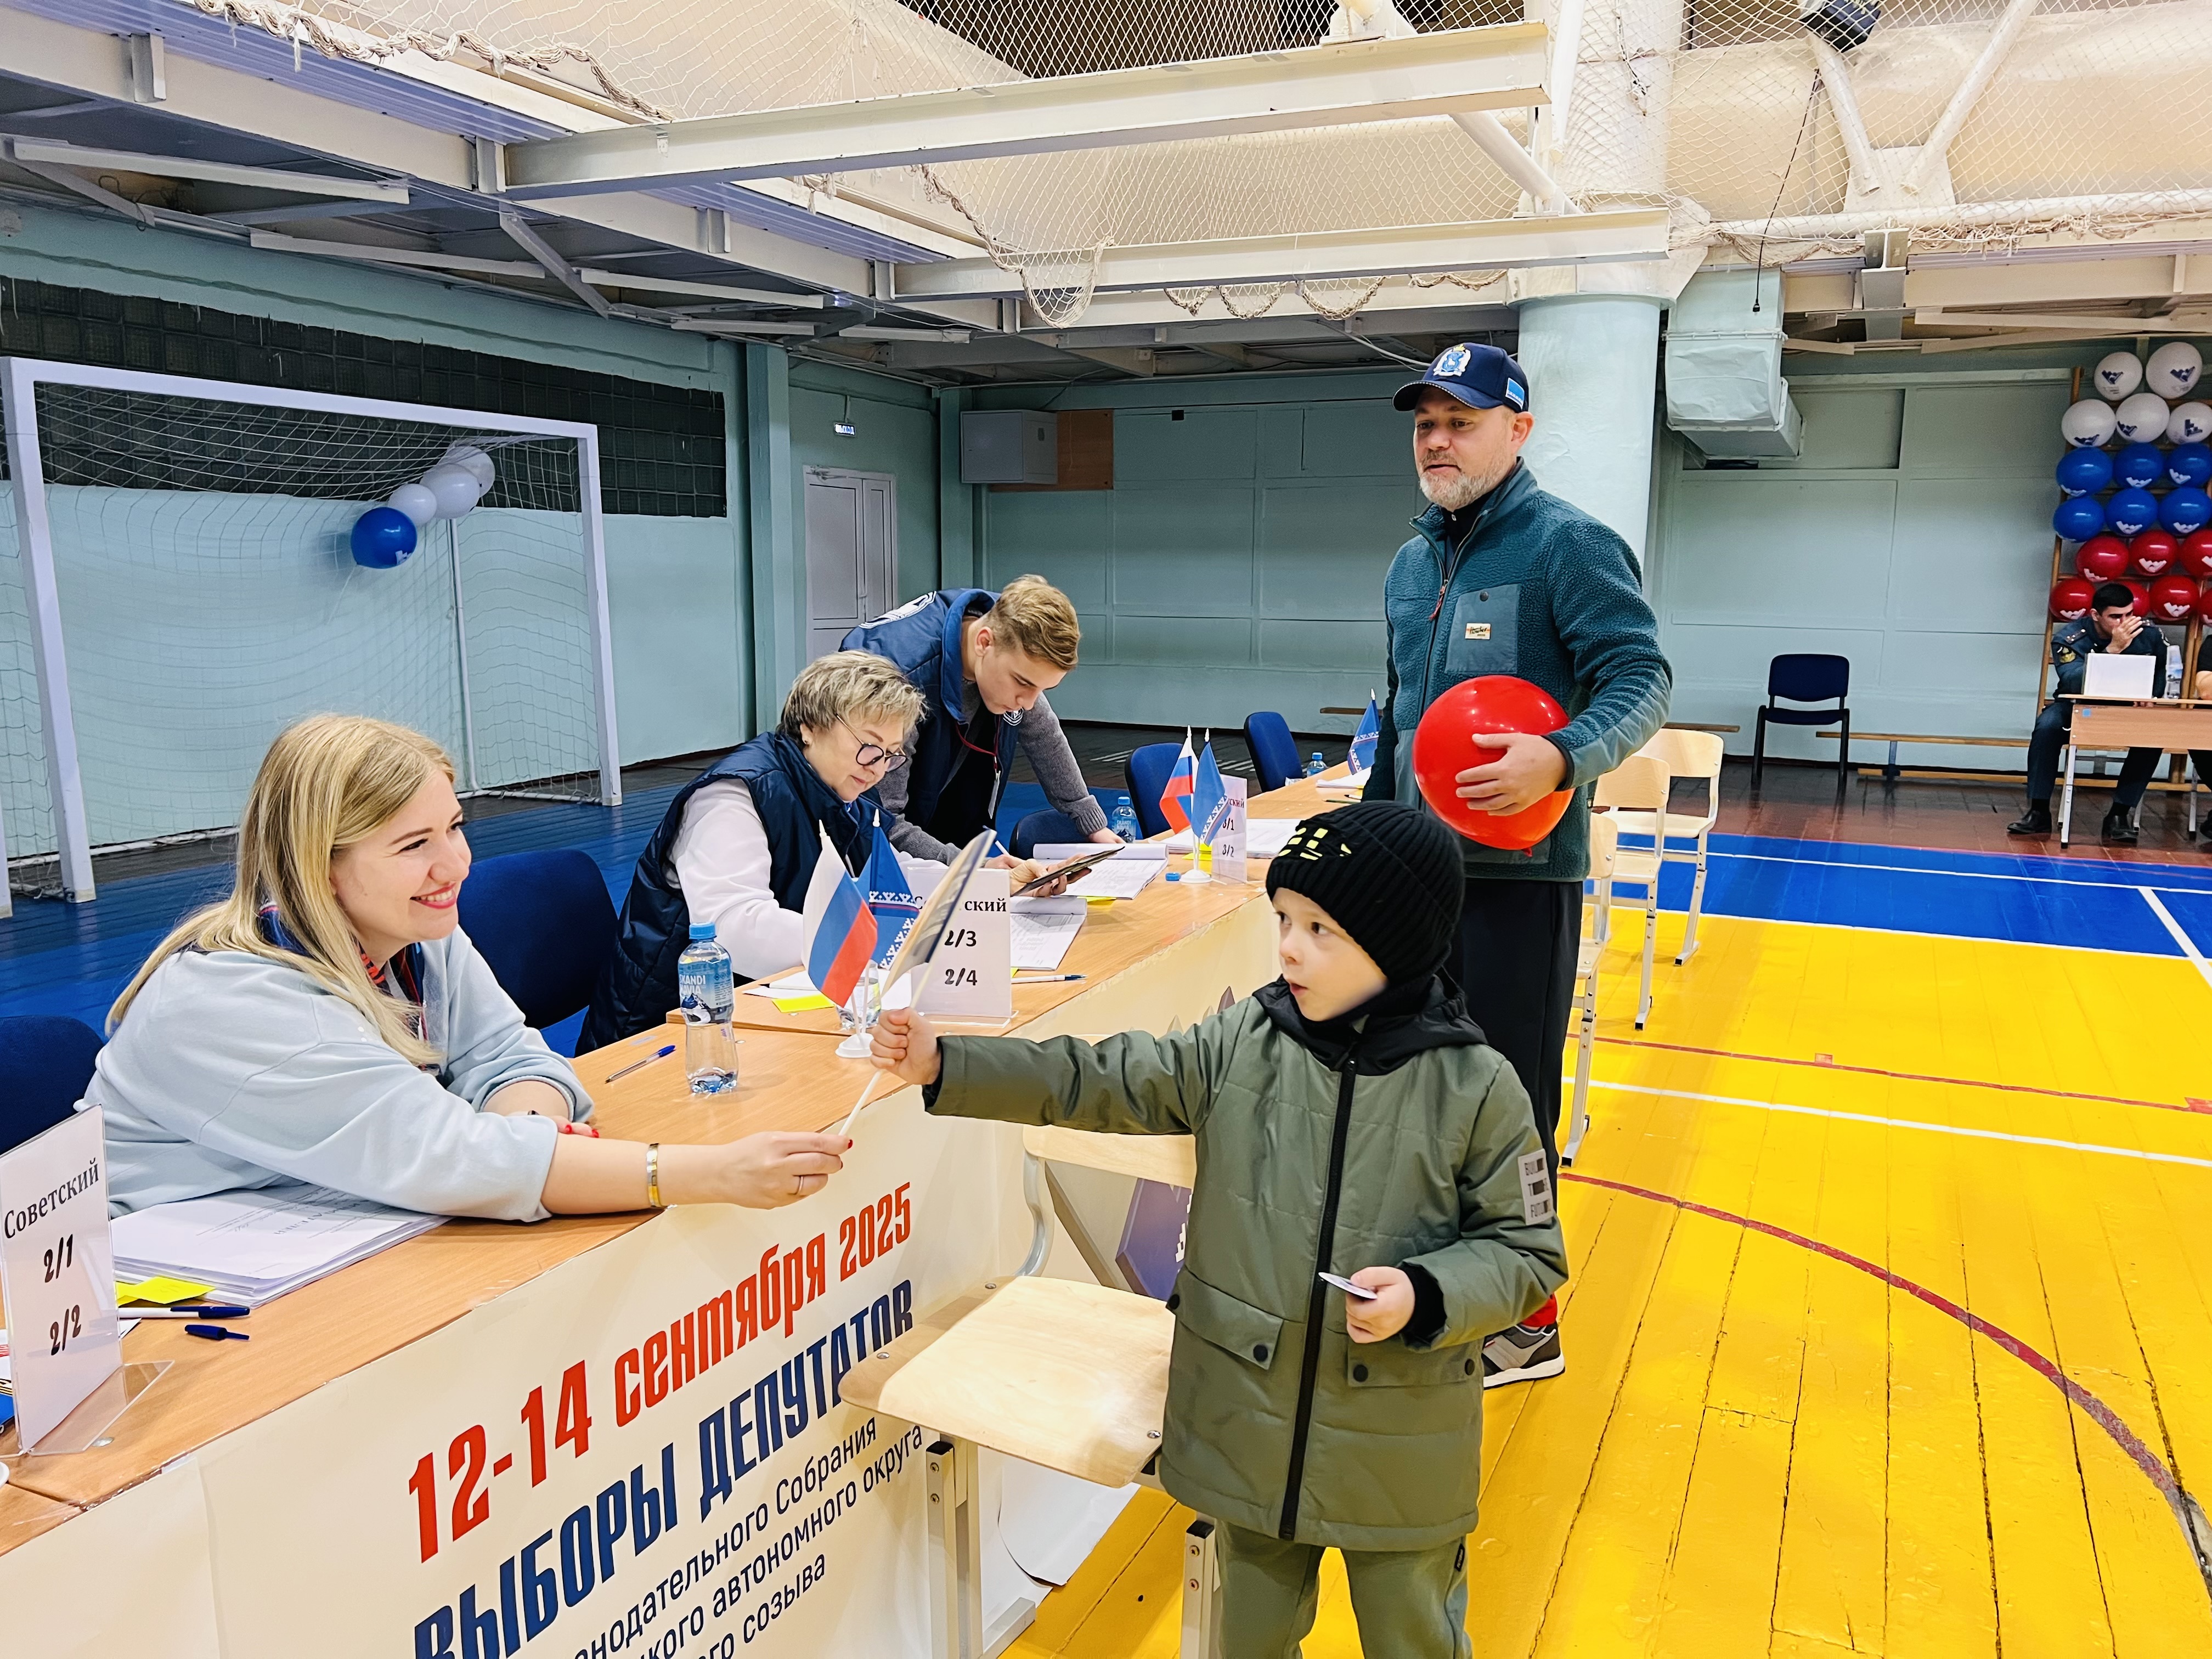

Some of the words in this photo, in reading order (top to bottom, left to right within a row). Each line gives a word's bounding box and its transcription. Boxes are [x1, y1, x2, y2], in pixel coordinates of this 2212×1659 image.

[1222, 844, 1234, 857] 3/2
[915, 896, 1007, 912] Сский
[944, 929, 977, 948] 2/3
[945, 968, 978, 986] 2/4
[4, 1157, 99, 1239] Советский
[43, 1233, 74, 1283] 2/1
[49, 1304, 82, 1356] 2/2
[408, 1359, 592, 1564] 12-14
[614, 1243, 826, 1428] сентября
[839, 1181, 911, 1282] 2025
[698, 1279, 913, 1523] ДЕПУТАТОВ
[776, 1417, 877, 1515] Собрания
[641, 1605, 704, 1659] кого
[713, 1481, 857, 1618] автономного
[862, 1425, 923, 1493] округа
[743, 1554, 825, 1644] созыва
